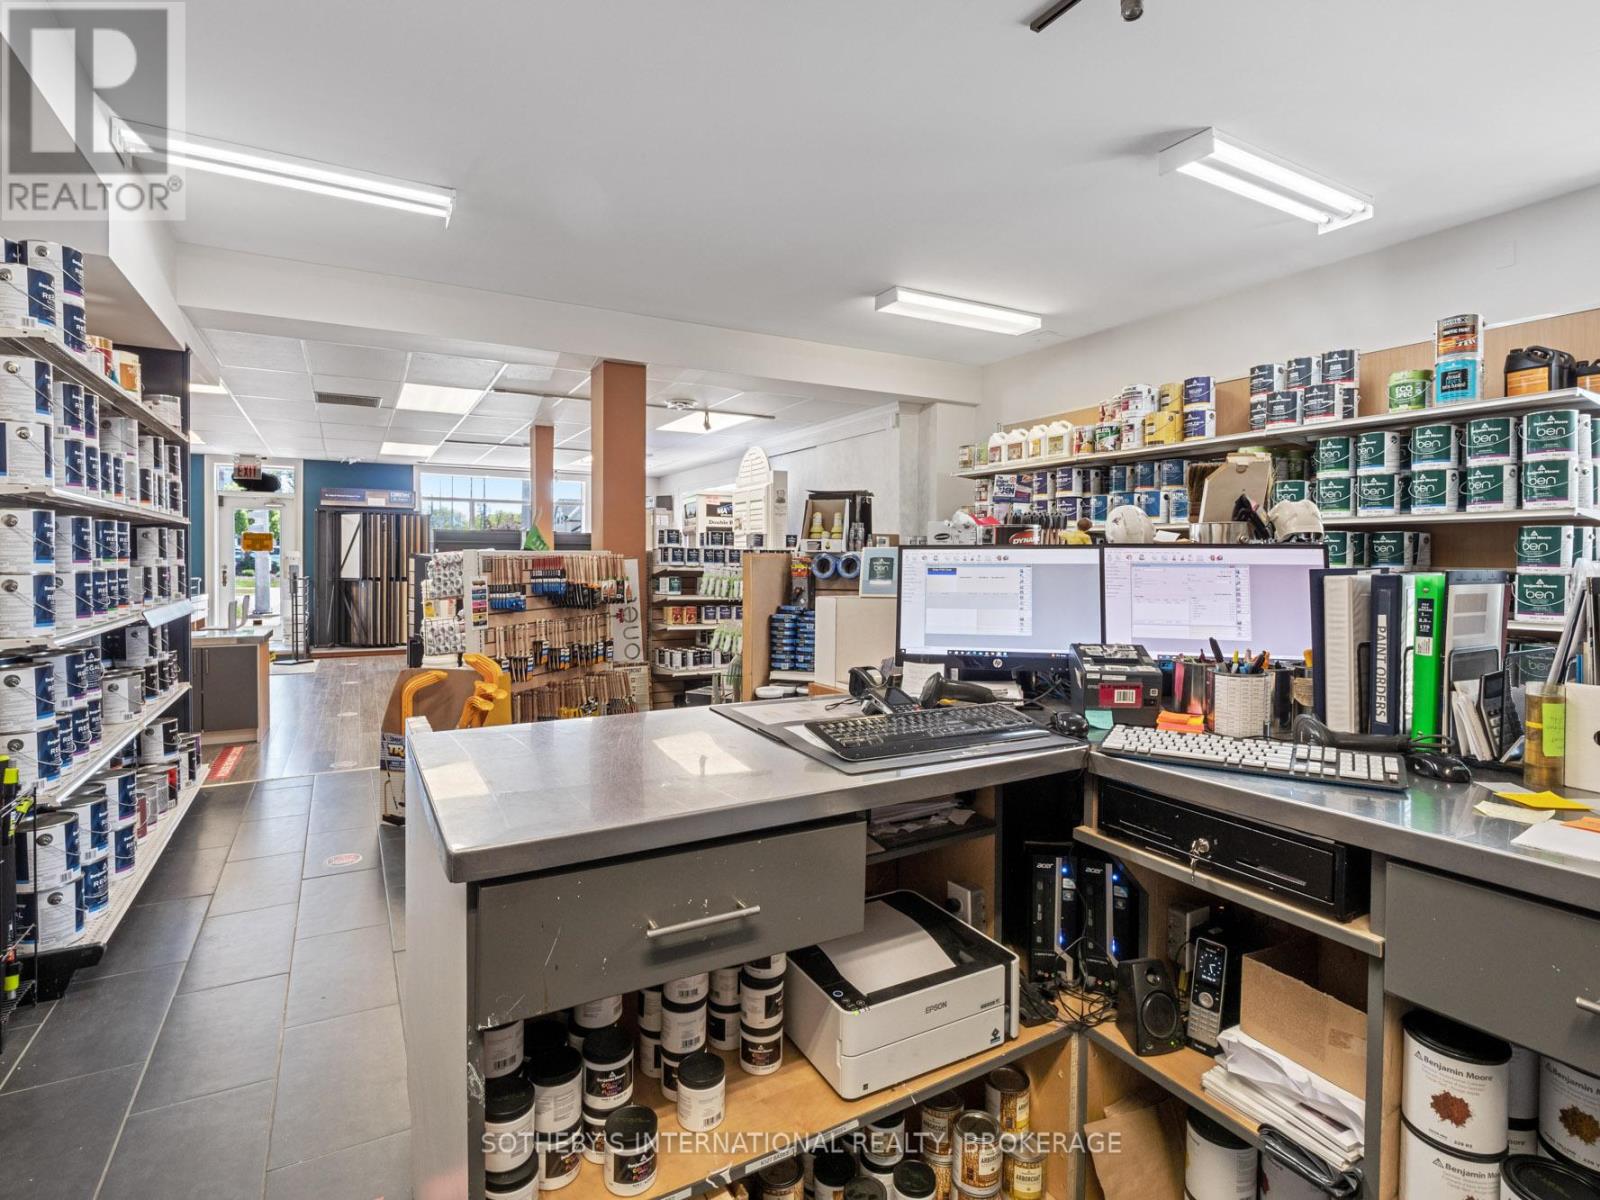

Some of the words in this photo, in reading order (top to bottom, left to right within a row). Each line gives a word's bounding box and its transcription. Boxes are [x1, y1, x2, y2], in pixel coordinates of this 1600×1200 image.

[1536, 426, 1566, 437] ben
[1417, 439, 1441, 449] ben
[1473, 433, 1499, 444] ben
[1319, 449, 1340, 459] ben
[237, 465, 257, 478] EXIT
[1468, 480, 1491, 490] ben
[1528, 475, 1556, 486] ben
[1320, 489, 1342, 499] ben
[1361, 486, 1385, 496] ben
[1413, 484, 1435, 495] ben
[1373, 543, 1394, 553] ben
[1522, 541, 1549, 551] ben
[1525, 589, 1554, 600] ben
[1377, 625, 1387, 664] PAINT
[1376, 667, 1387, 718] ORDERS
[1085, 866, 1103, 874] acer
[925, 1001, 948, 1015] EPSON
[1423, 1055, 1464, 1079] Benjamin
[1466, 1071, 1493, 1082] Moore
[1551, 1067, 1594, 1094] Benjamin
[1445, 1162, 1486, 1180] Benjamin
